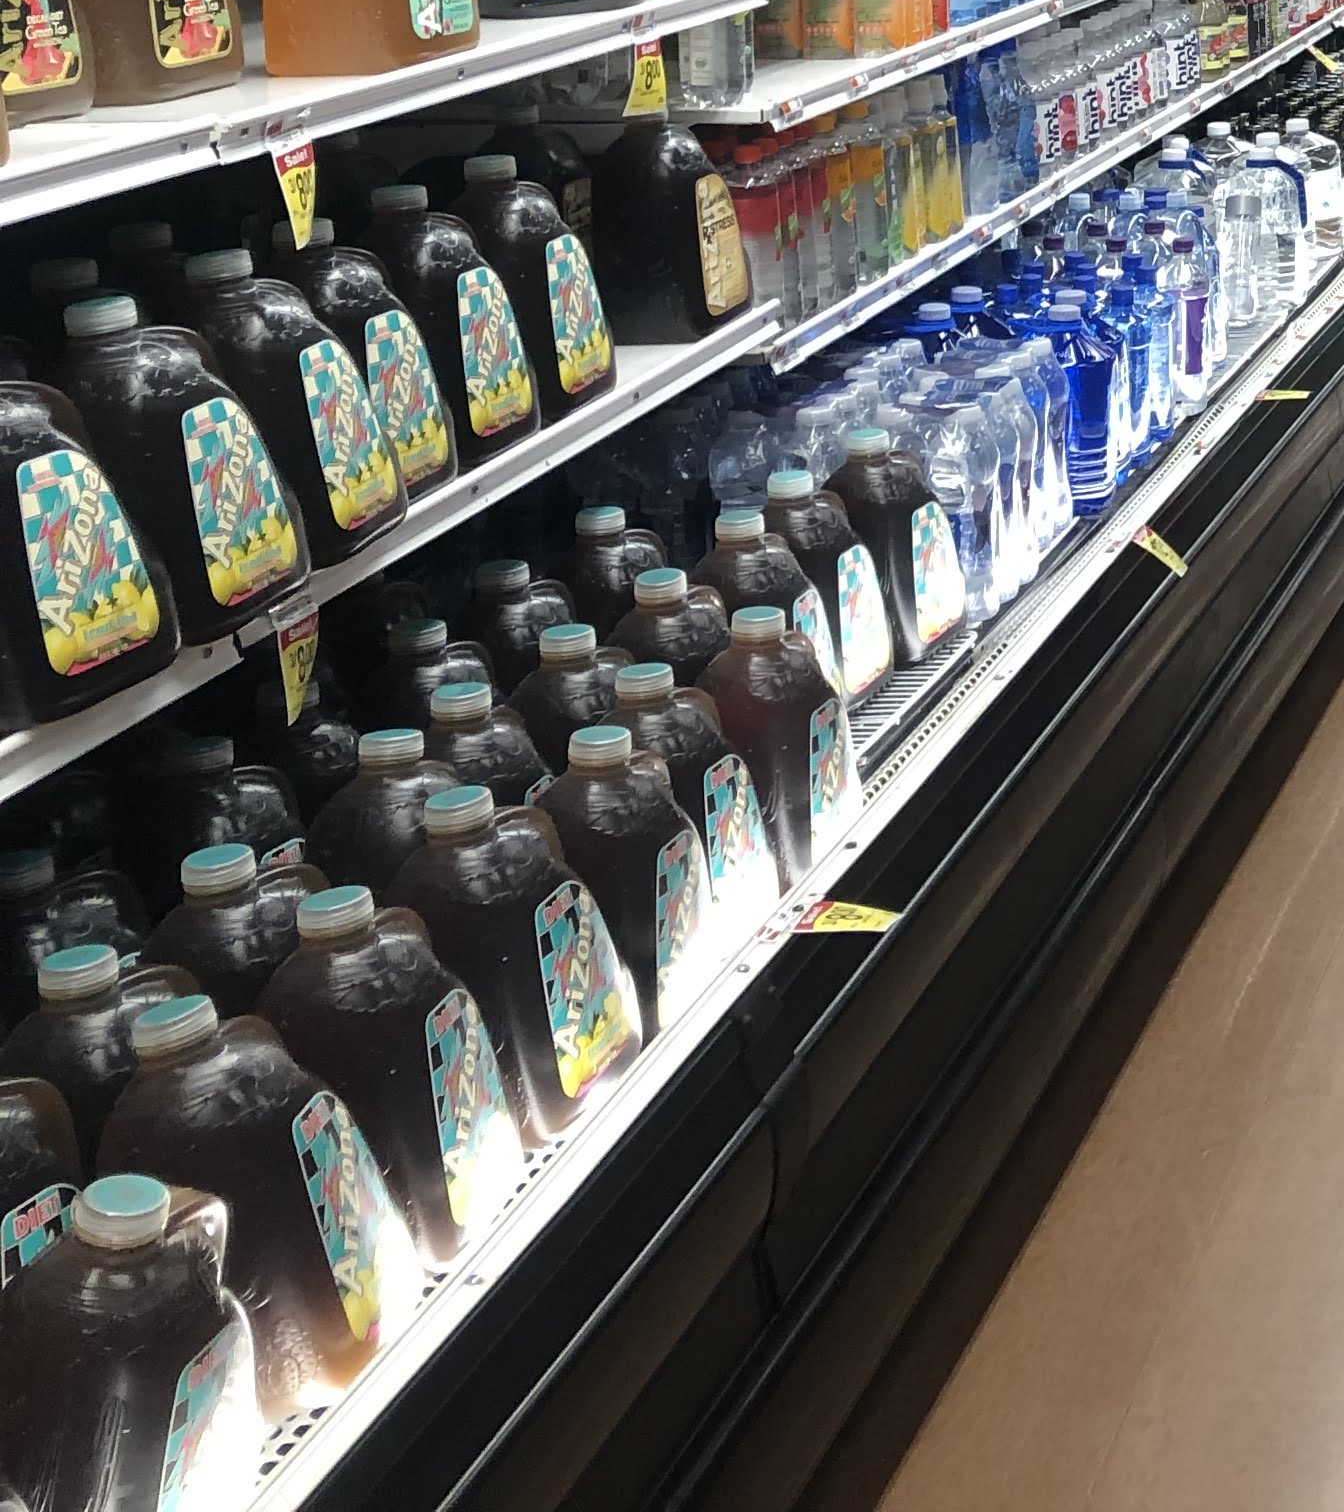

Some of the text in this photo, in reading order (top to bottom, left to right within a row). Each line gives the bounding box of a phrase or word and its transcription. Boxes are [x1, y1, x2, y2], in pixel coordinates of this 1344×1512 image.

[284, 148, 309, 168] Sale!
[466, 277, 504, 407] AriZona
[554, 247, 588, 367] AriZona
[202, 409, 250, 568] AriZona
[37, 465, 99, 635] AriZona
[543, 894, 571, 925] DIET
[301, 1100, 336, 1141] DIET
[14, 1199, 60, 1239] DIET
